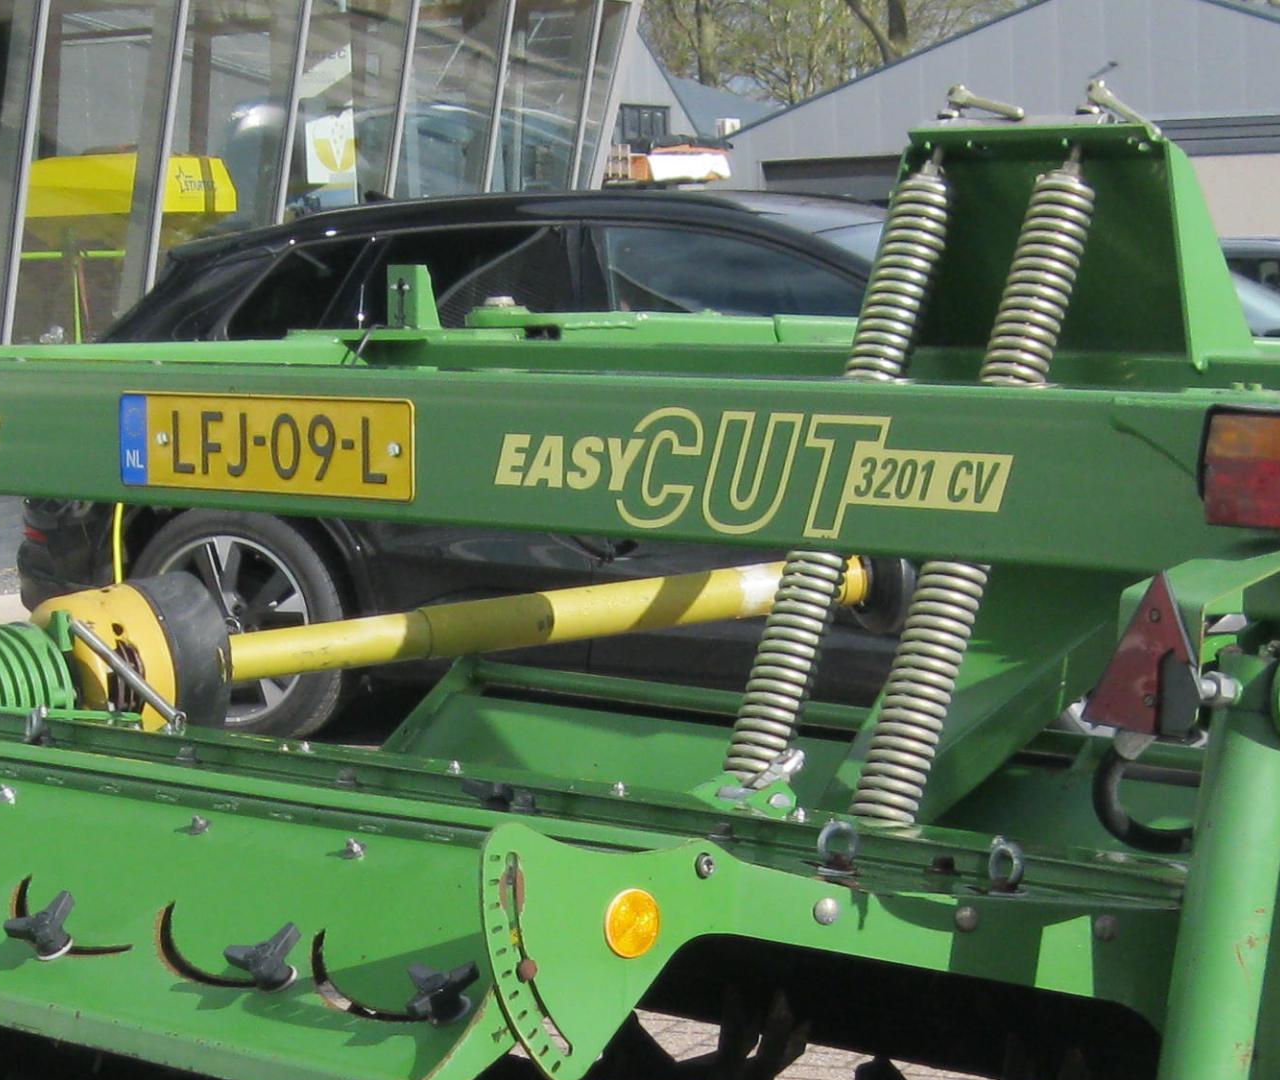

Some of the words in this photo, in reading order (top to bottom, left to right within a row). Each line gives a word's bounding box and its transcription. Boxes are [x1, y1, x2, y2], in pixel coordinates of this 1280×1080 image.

[125, 449, 145, 469] NL
[172, 410, 388, 485] LFJ-09-L
[854, 456, 936, 500] 3201
[947, 460, 1003, 504] CV
